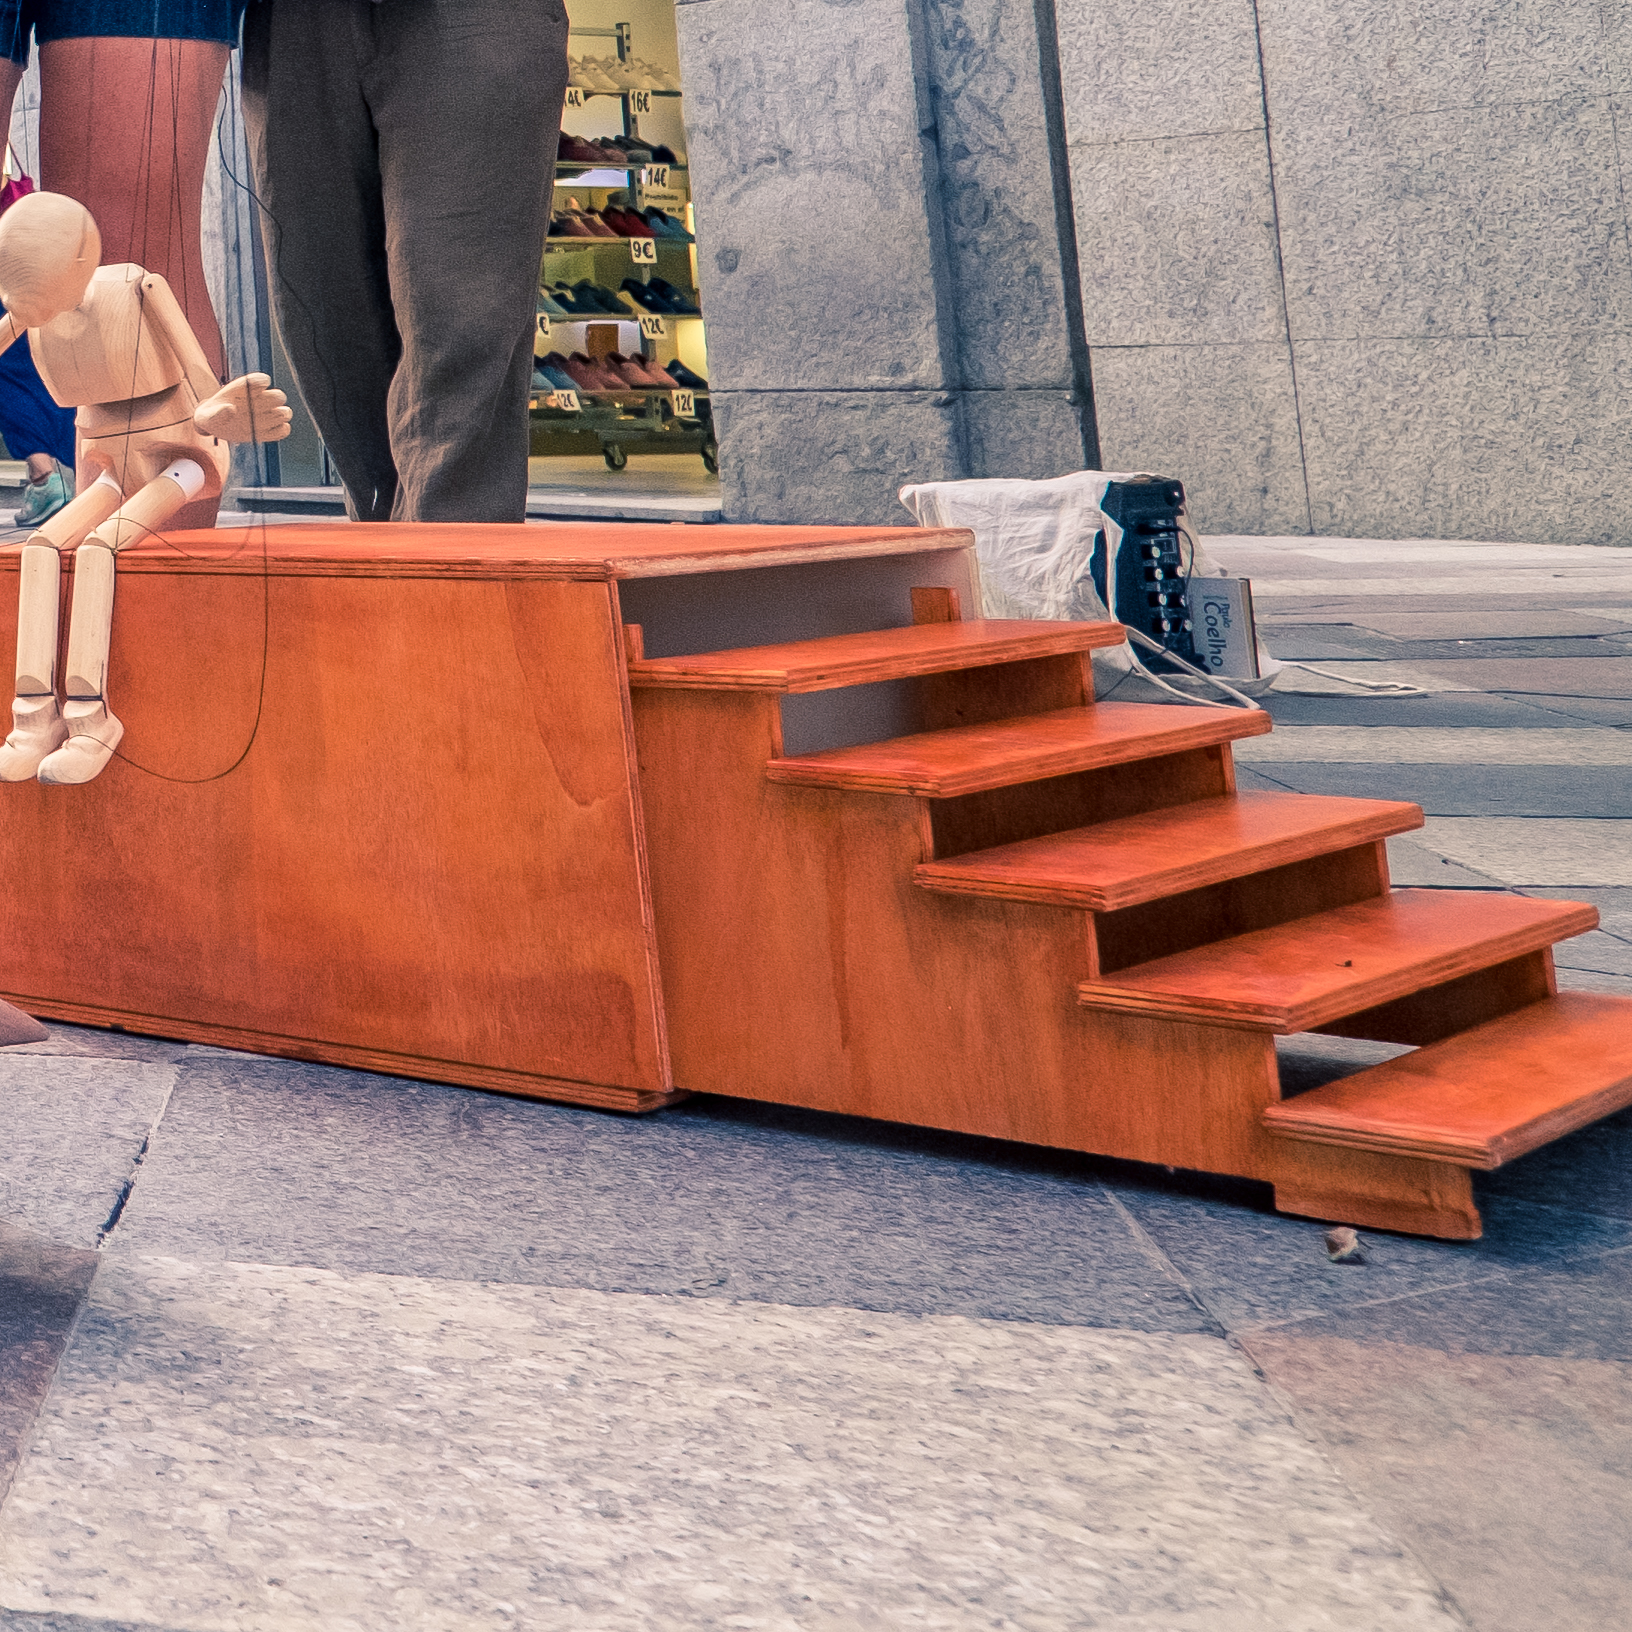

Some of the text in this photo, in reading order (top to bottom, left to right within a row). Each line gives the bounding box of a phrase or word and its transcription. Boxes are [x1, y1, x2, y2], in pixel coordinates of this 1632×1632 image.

[631, 93, 650, 112] 16€
[648, 168, 666, 187] 14€
[632, 240, 654, 259] 9€
[642, 317, 665, 335] 12€
[1220, 602, 1233, 629] Paulo
[1203, 601, 1228, 667] Coelho
